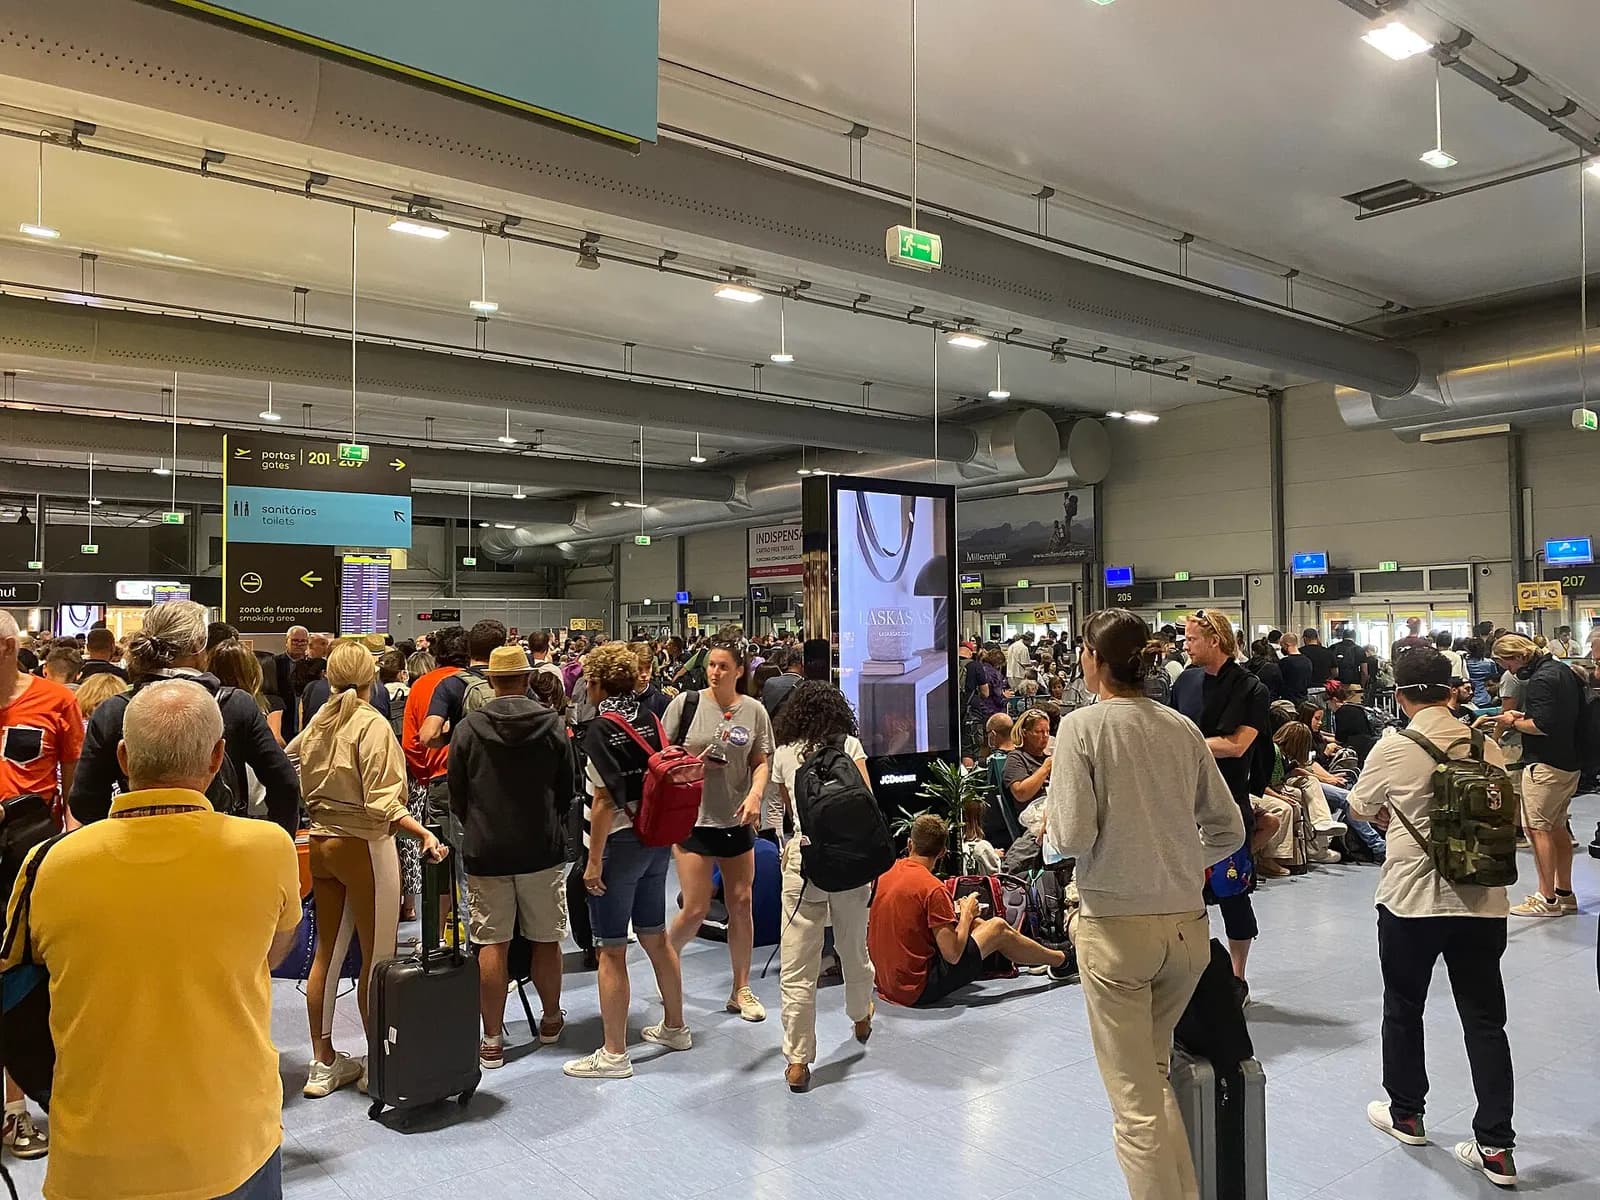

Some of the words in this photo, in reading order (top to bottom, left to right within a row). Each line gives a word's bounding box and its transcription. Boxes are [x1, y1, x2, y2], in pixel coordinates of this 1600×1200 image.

[261, 450, 296, 461] portas
[261, 461, 290, 471] gates
[261, 504, 317, 517] sanitários
[262, 516, 295, 526] toilets
[966, 551, 1007, 562] Millennium
[1562, 575, 1586, 587] 207
[1306, 584, 1326, 594] 206
[970, 597, 982, 606] 204
[1117, 592, 1132, 602] 205
[263, 605, 274, 613] de
[276, 605, 323, 613] fumadores
[239, 614, 275, 623] smoking
[880, 774, 917, 785] JCDecaux
